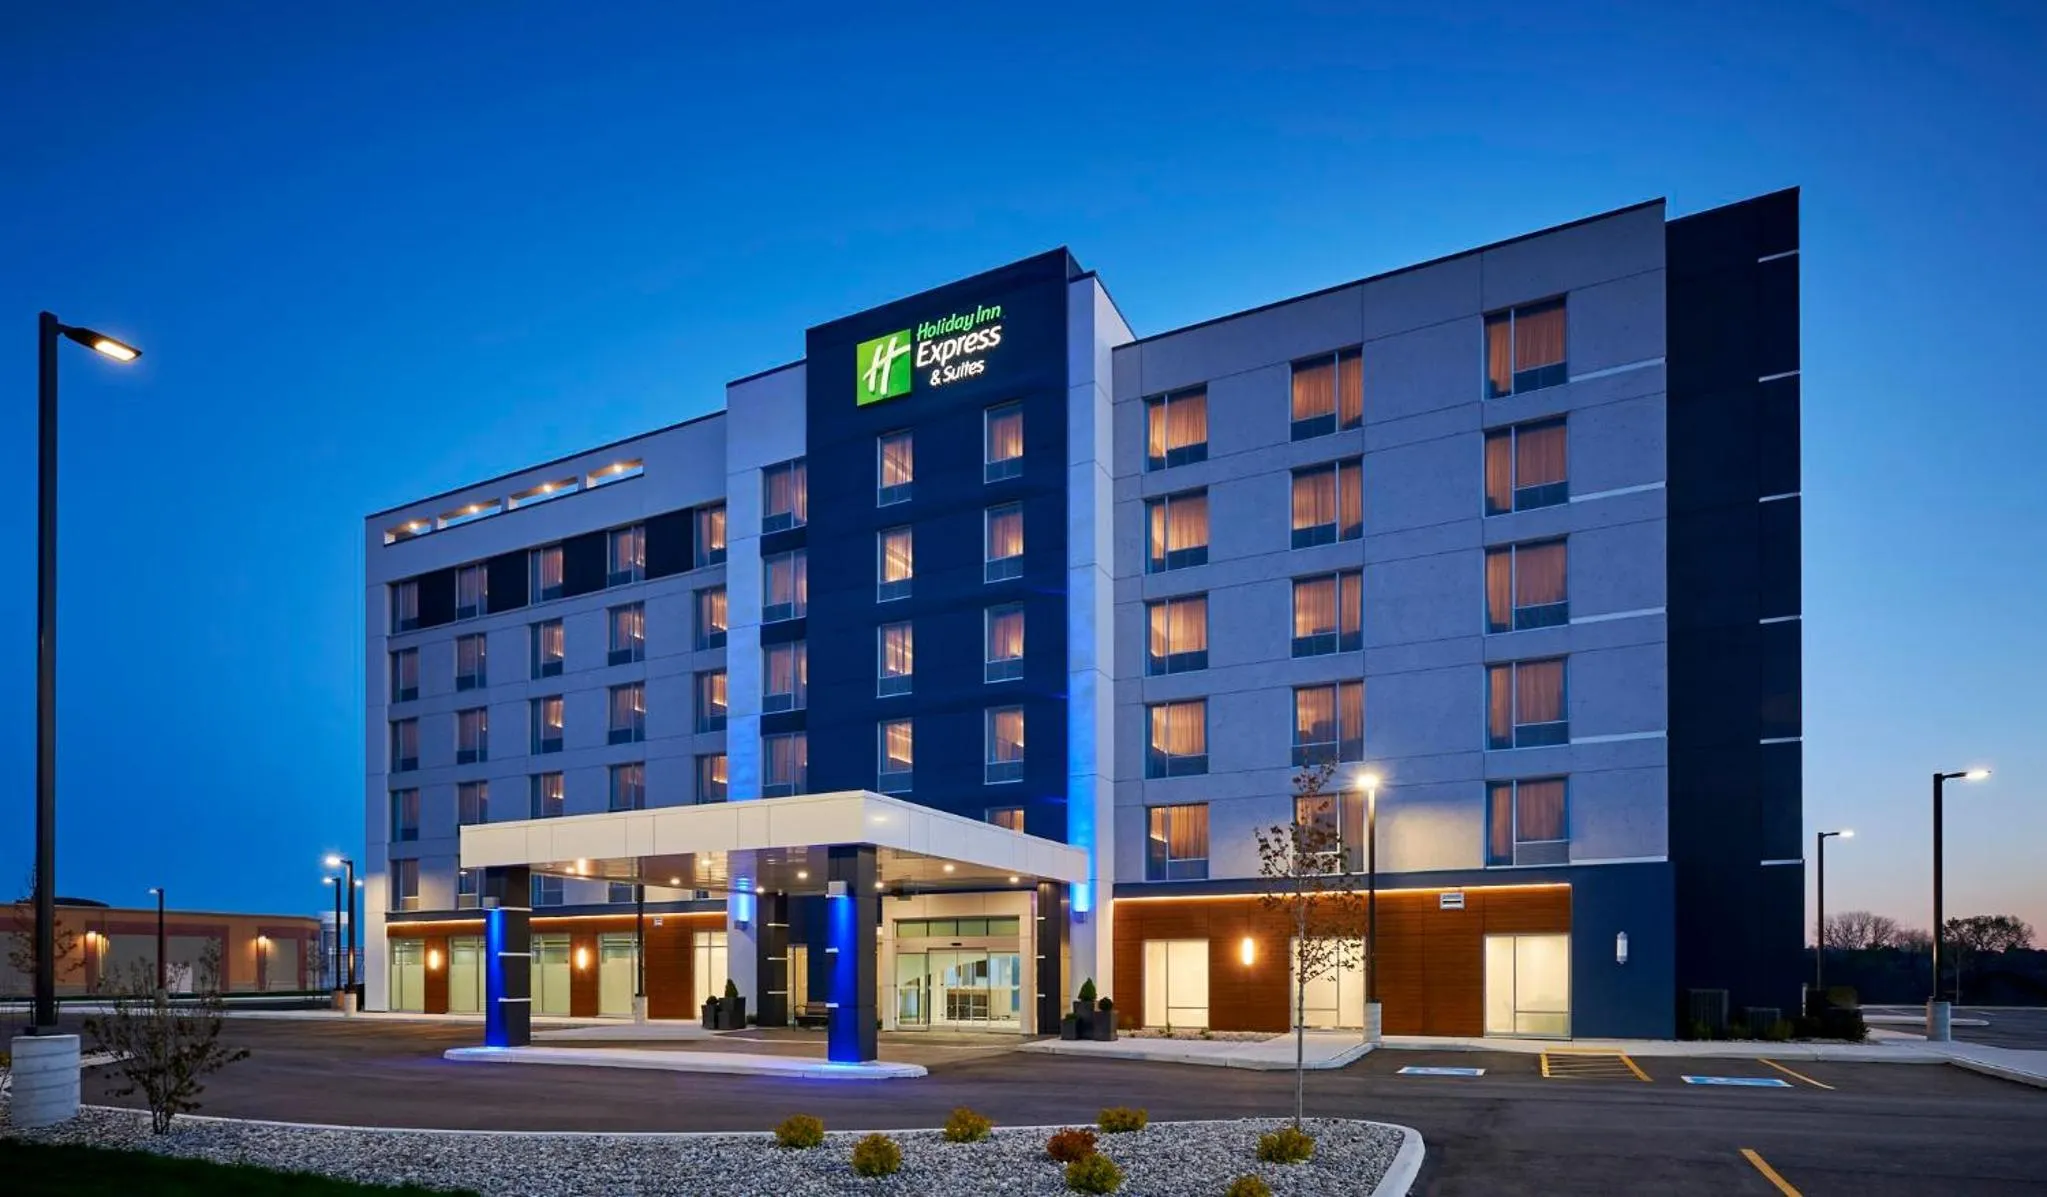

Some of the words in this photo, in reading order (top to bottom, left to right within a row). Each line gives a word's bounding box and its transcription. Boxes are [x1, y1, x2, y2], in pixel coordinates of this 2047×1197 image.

[917, 313, 974, 341] Holiday
[976, 305, 1001, 323] Inn
[916, 325, 1002, 368] Express
[929, 369, 941, 386] &
[943, 360, 985, 383] Suites
